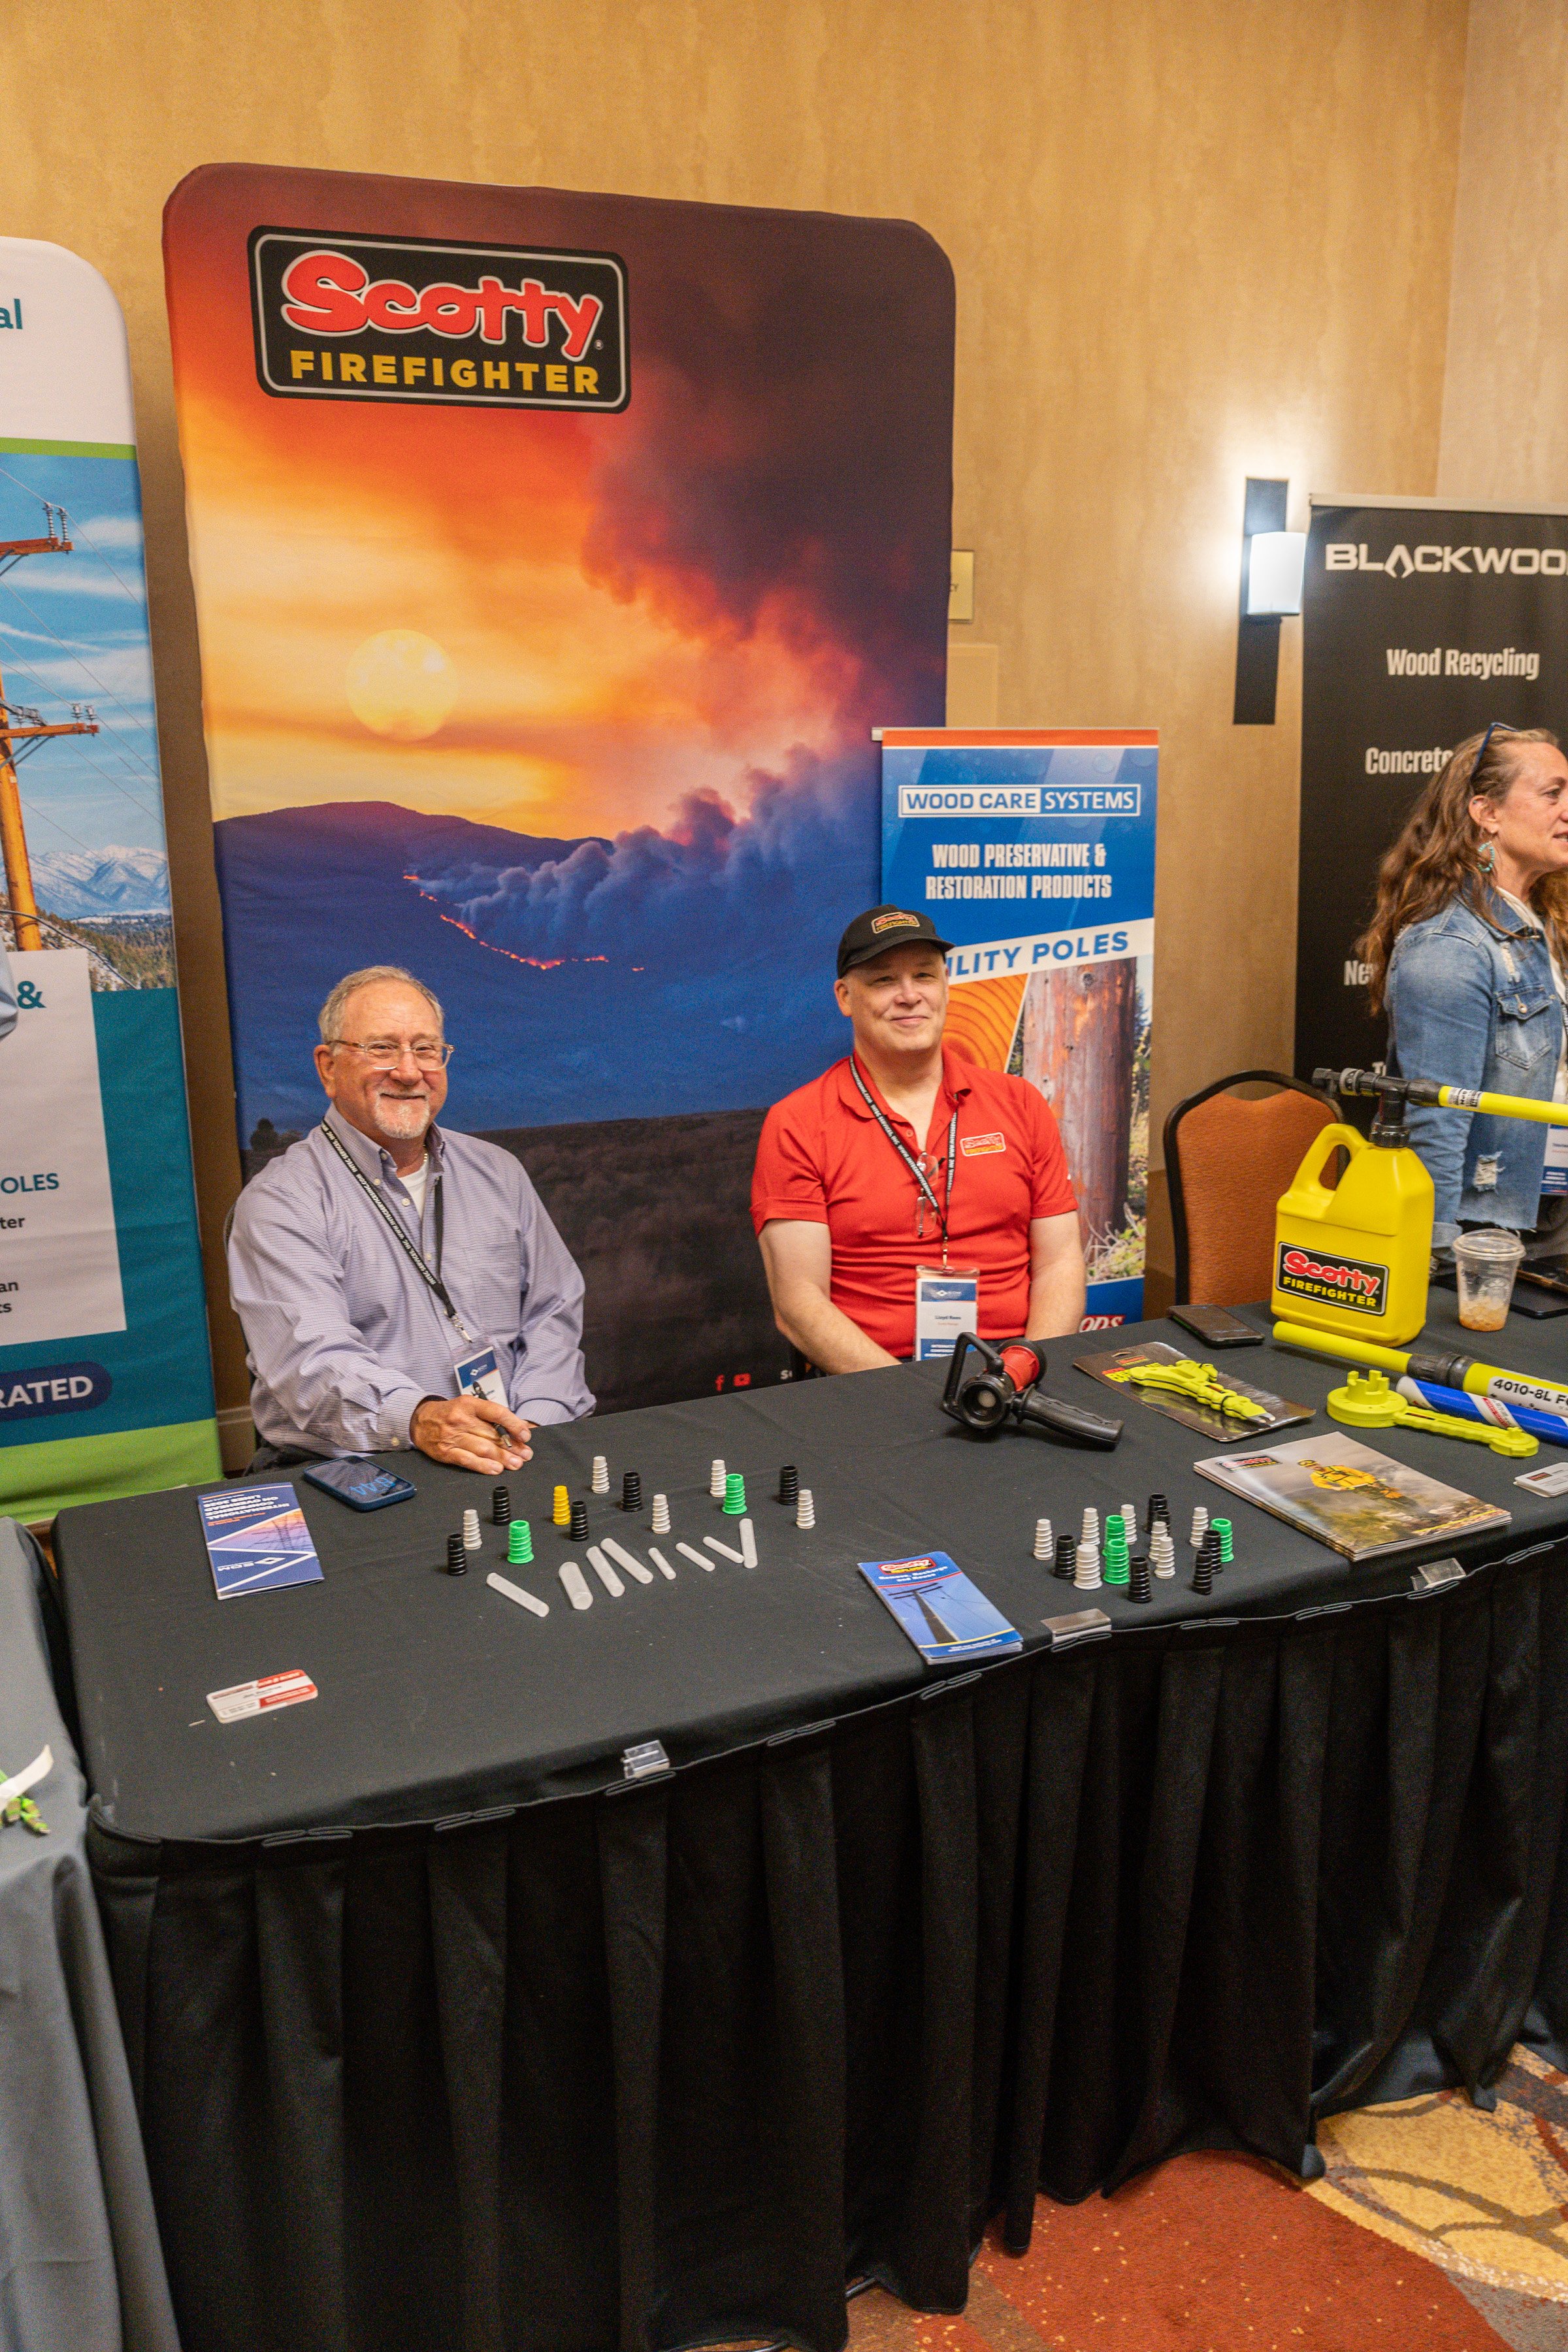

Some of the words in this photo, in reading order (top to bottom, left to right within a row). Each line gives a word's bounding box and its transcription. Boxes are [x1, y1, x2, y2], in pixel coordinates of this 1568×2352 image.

[281, 250, 604, 362] Scotty
[290, 350, 600, 395] FIREFIGHTER
[1325, 544, 1568, 578] BLACKWOO
[1386, 647, 1442, 676] Wood
[1445, 647, 1540, 681] Recycling
[907, 792, 974, 809] WOOD
[979, 792, 1037, 809] CARE
[1045, 791, 1134, 810] SYSTEMS
[932, 844, 980, 868] WOOD
[985, 843, 1090, 868] PRESERVATIVE
[1094, 843, 1106, 866] &
[926, 875, 1027, 900] RESTORATION
[1031, 874, 1113, 898] PRODUCTS
[1031, 931, 1129, 965] POLES
[17, 981, 46, 1009] &
[0, 1173, 59, 1194] OLES
[0, 1217, 25, 1230] ter
[1282, 1250, 1380, 1296] Scotty
[1282, 1276, 1377, 1307] FIREFIGHTER
[1494, 1379, 1552, 1402] 4010-8L
[205, 1503, 290, 1520] INTERNATIONAL
